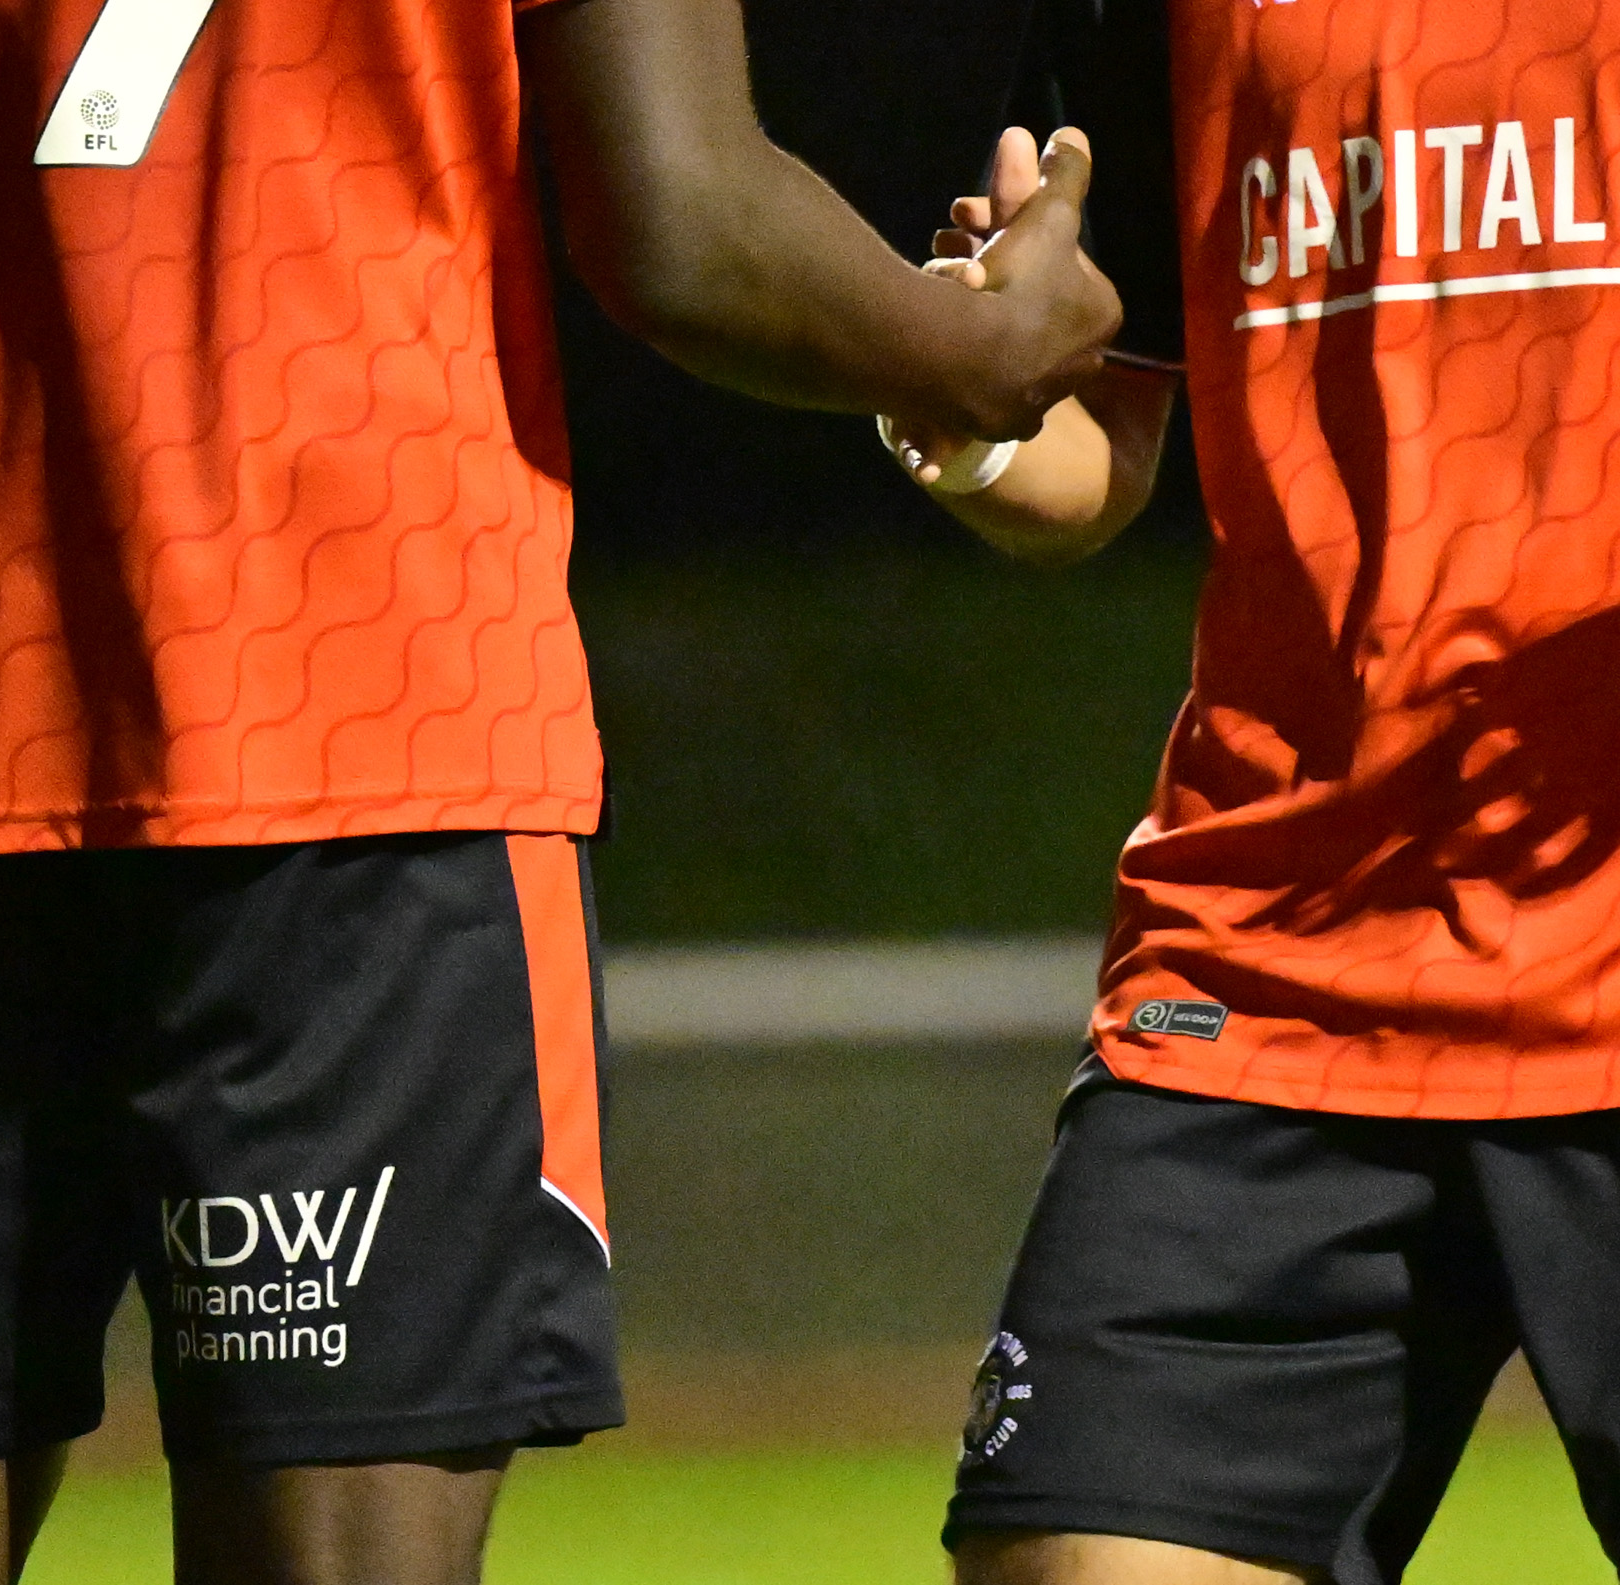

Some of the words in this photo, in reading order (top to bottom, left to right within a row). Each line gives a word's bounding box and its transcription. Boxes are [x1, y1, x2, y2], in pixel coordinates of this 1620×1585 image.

[85, 134, 117, 150] EFL
[1237, 117, 1606, 287] CAPITAL
[177, 1317, 347, 1368] planning
